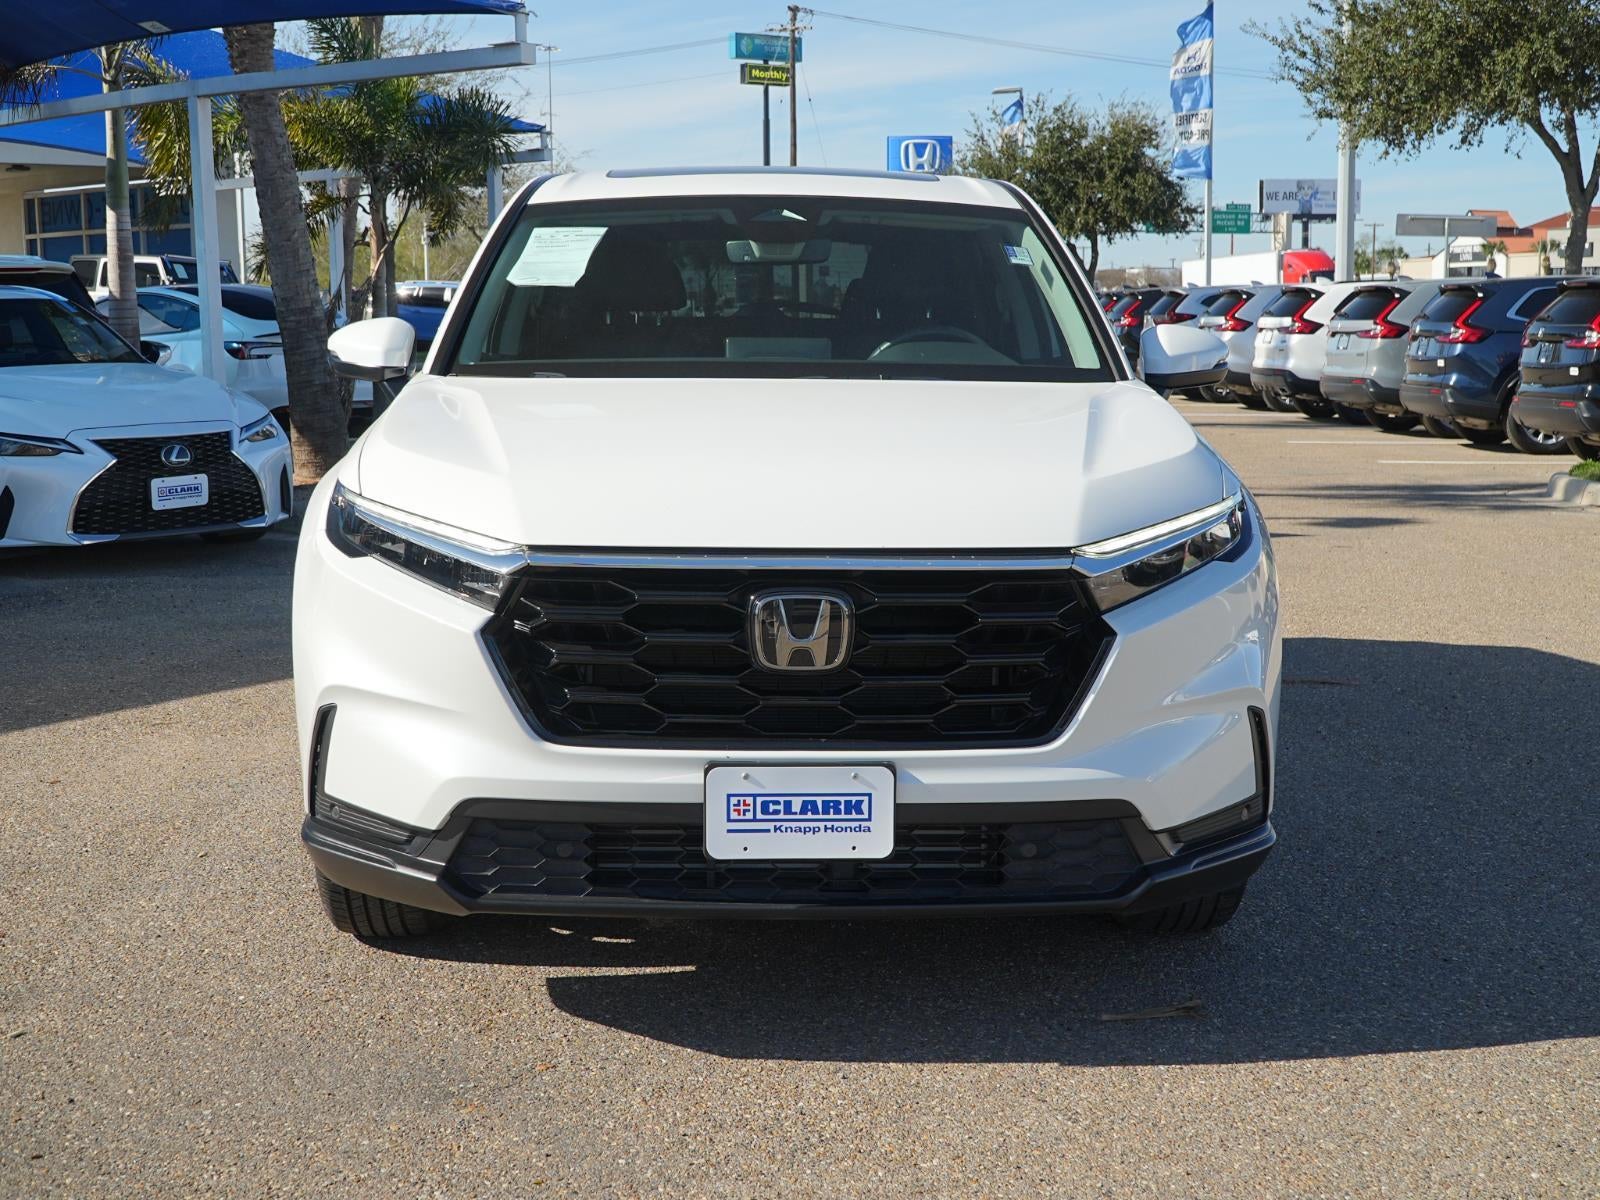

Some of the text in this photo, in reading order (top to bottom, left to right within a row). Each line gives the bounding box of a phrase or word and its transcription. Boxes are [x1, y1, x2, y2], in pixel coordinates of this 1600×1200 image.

[751, 69, 787, 81] Monthly
[1265, 191, 1280, 201] WE
[168, 486, 200, 494] CLARK
[760, 799, 865, 816] CLARK
[773, 824, 872, 835] Knapp Honda
